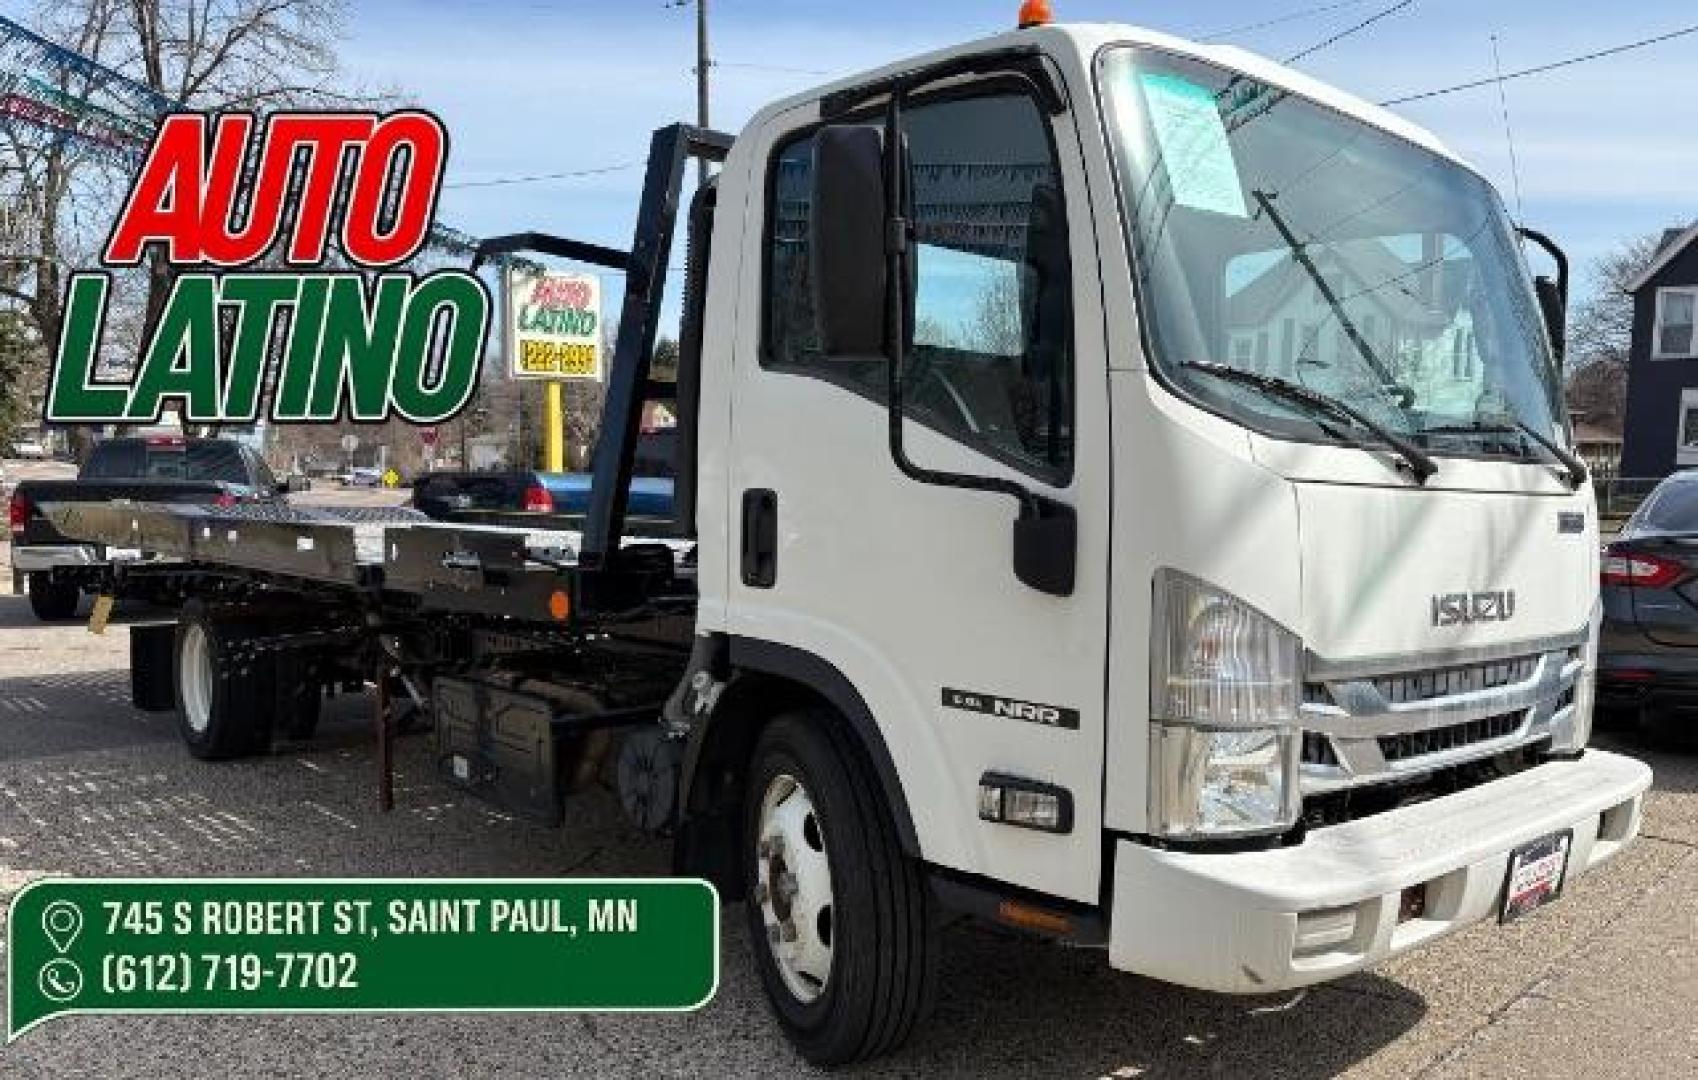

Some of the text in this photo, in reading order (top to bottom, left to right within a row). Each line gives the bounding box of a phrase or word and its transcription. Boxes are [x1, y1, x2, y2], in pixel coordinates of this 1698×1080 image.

[518, 306, 597, 335] LATINO
[1432, 588, 1515, 626] ISUZU
[994, 699, 1060, 724] NRR
